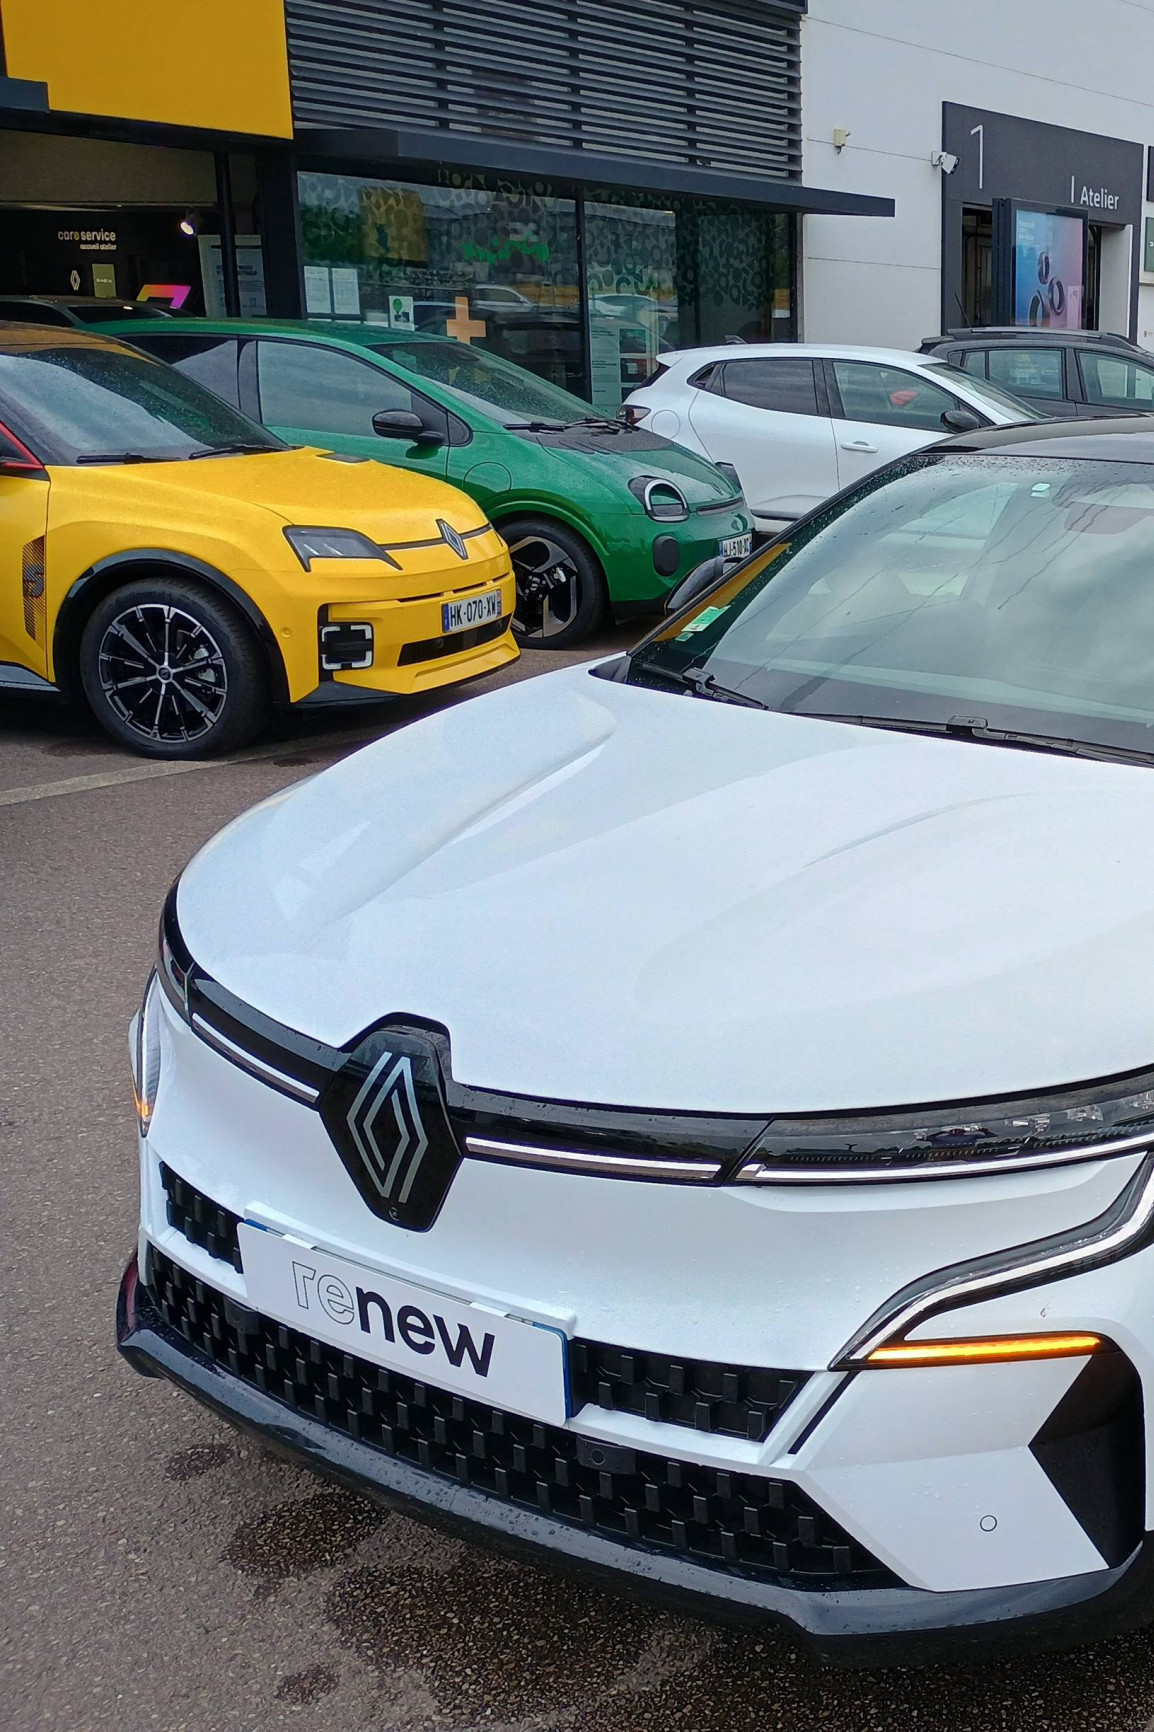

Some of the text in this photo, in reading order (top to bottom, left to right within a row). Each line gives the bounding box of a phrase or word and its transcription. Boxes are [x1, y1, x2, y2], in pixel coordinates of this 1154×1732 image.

[970, 124, 984, 190] 1
[1079, 186, 1120, 211] Atelier
[57, 228, 116, 241] care service
[292, 1260, 496, 1378] renew
